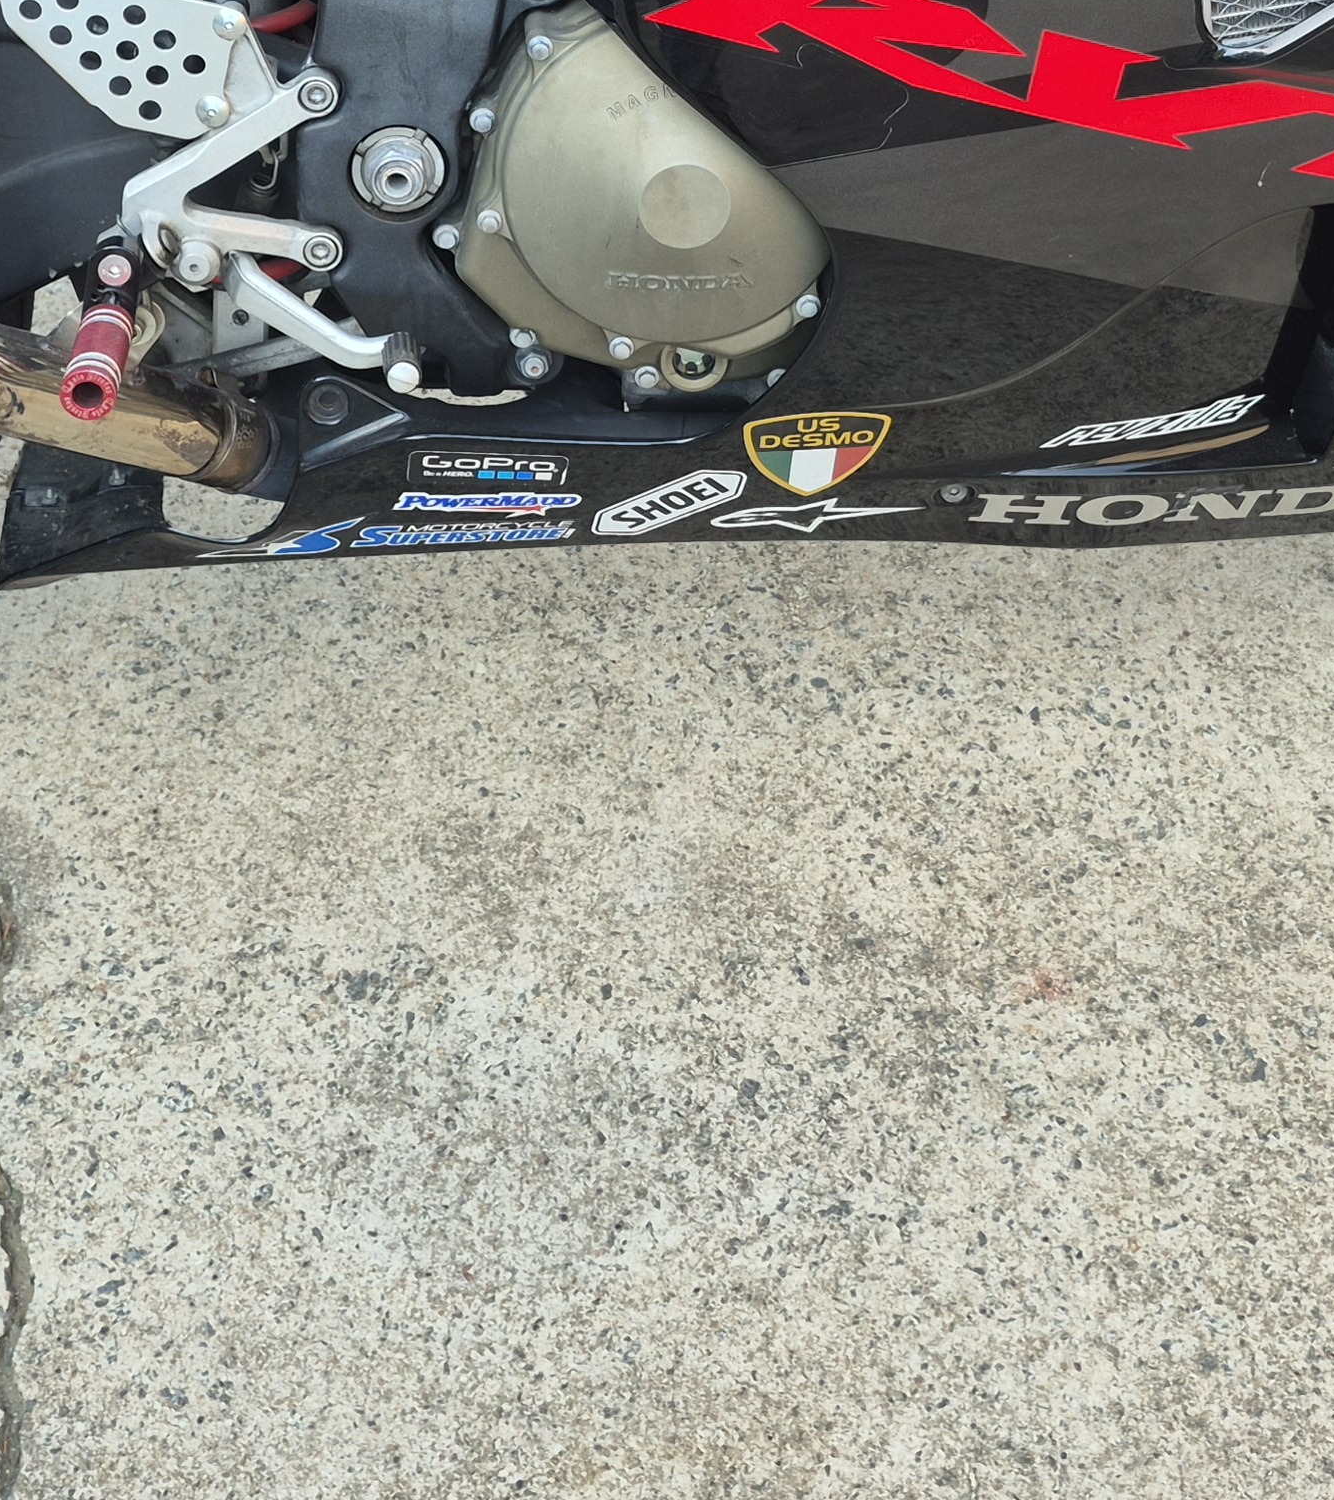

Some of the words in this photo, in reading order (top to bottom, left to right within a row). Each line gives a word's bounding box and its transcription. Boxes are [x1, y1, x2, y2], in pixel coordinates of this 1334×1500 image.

[605, 271, 754, 291] HONDA
[797, 418, 841, 433] US
[759, 430, 874, 449] DESMO
[422, 455, 556, 471] GoPro
[611, 477, 730, 529] SHOEI
[407, 520, 575, 532] MOTORCYCLE
